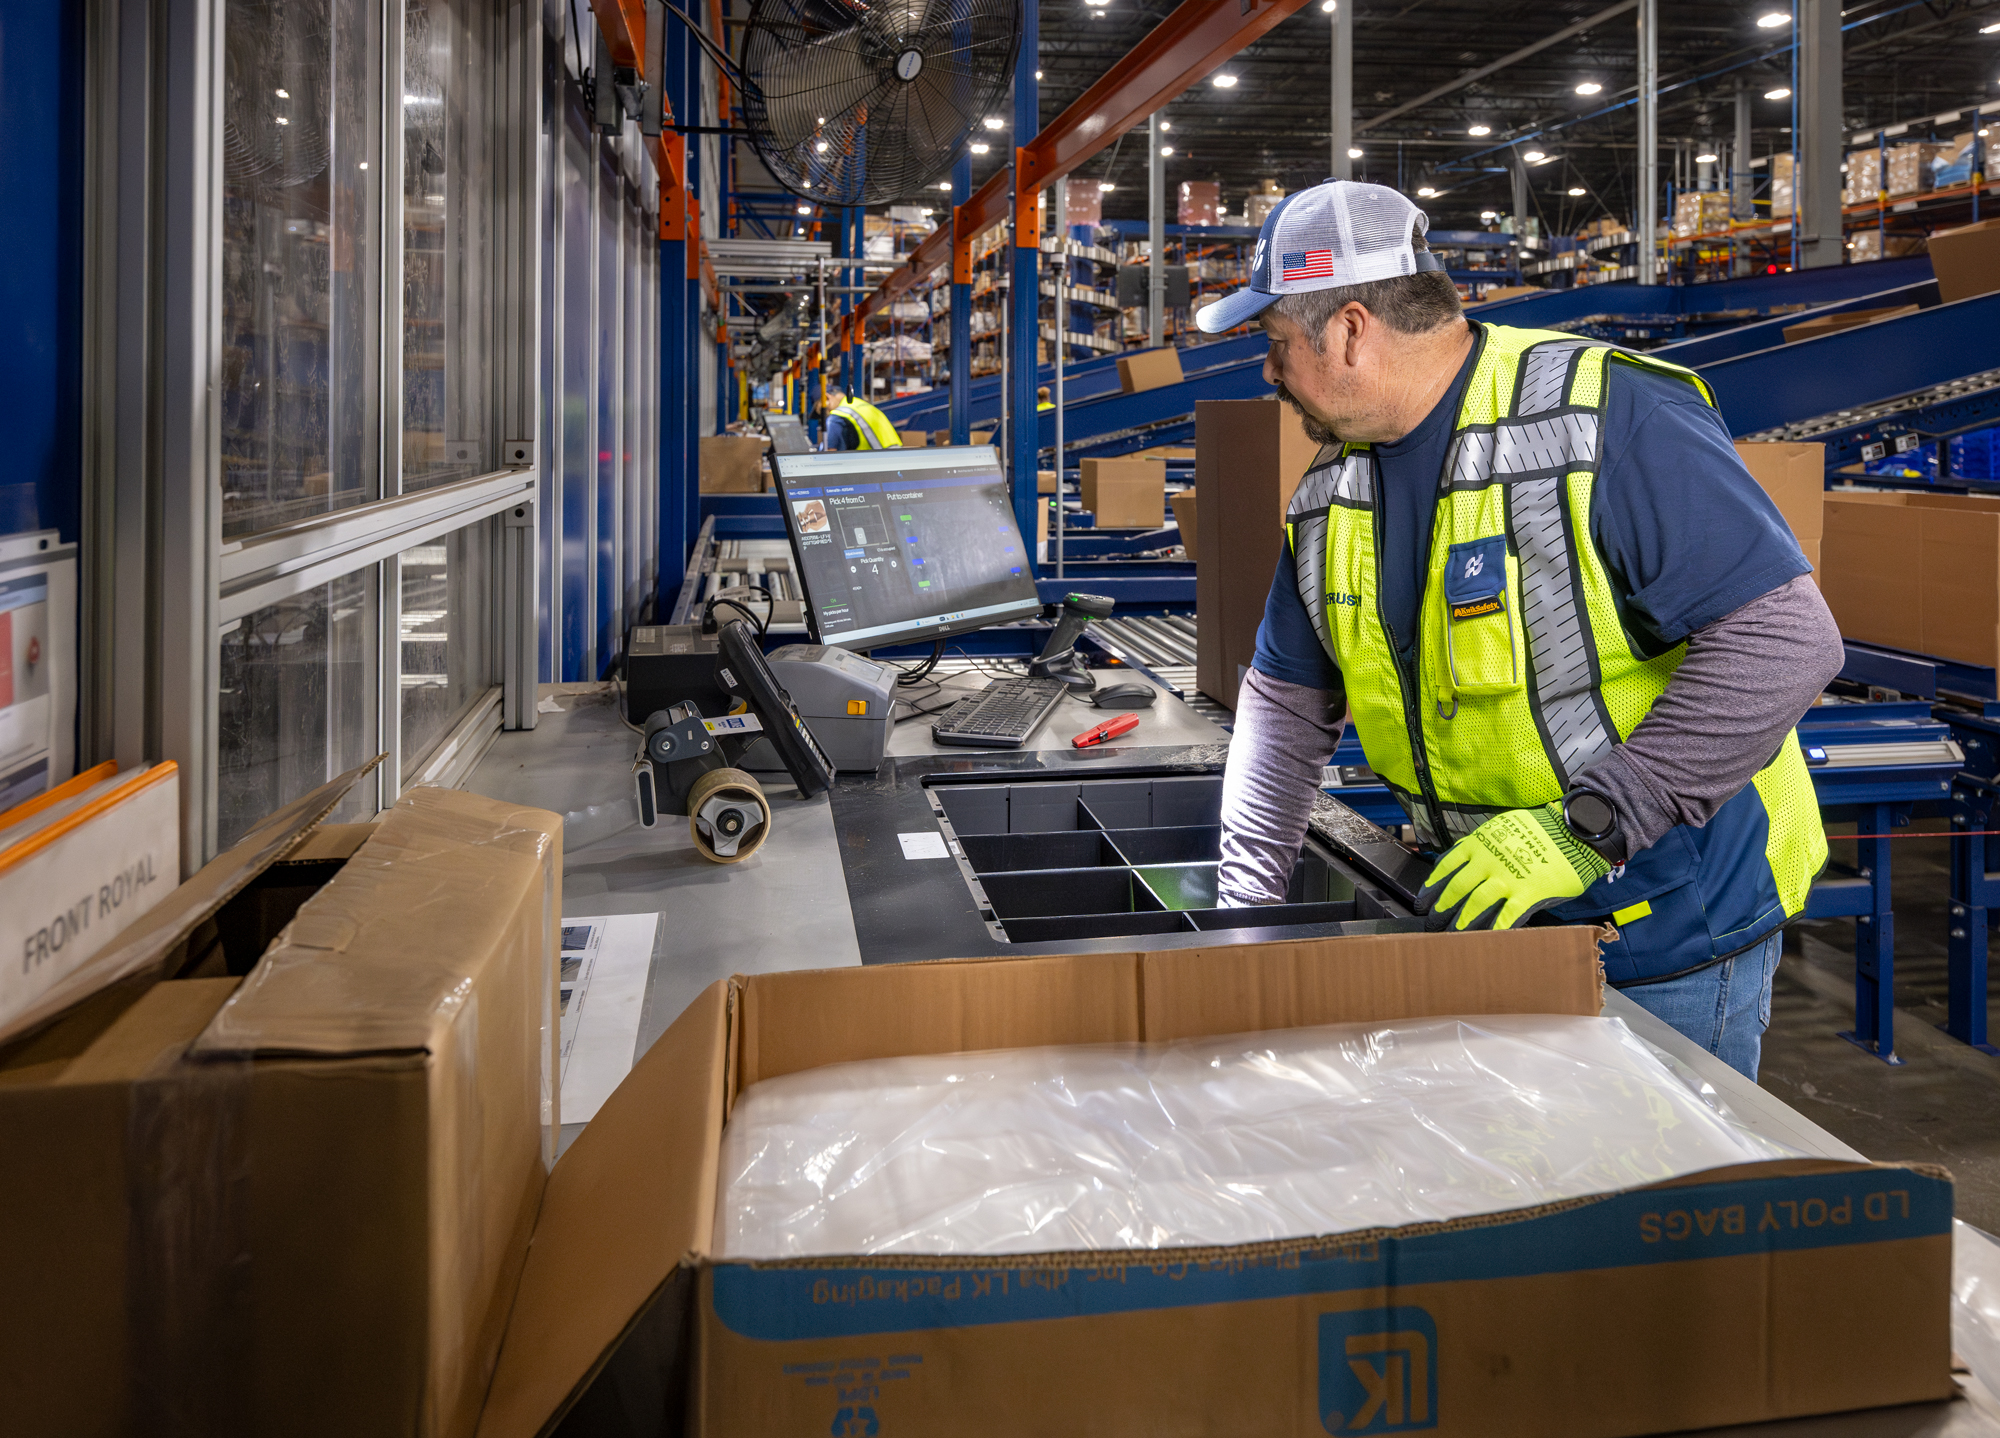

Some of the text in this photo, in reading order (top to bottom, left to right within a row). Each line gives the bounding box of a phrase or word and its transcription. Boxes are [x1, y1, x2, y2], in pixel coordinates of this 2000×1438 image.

[830, 497, 841, 505] Pick
[872, 564, 879, 575] 4
[23, 854, 157, 975] FRONT ROYAL
[1639, 1190, 1910, 1244] LD POLY BAGS
[971, 1272, 1009, 1298] LK
[1346, 1329, 1428, 1430] LK
